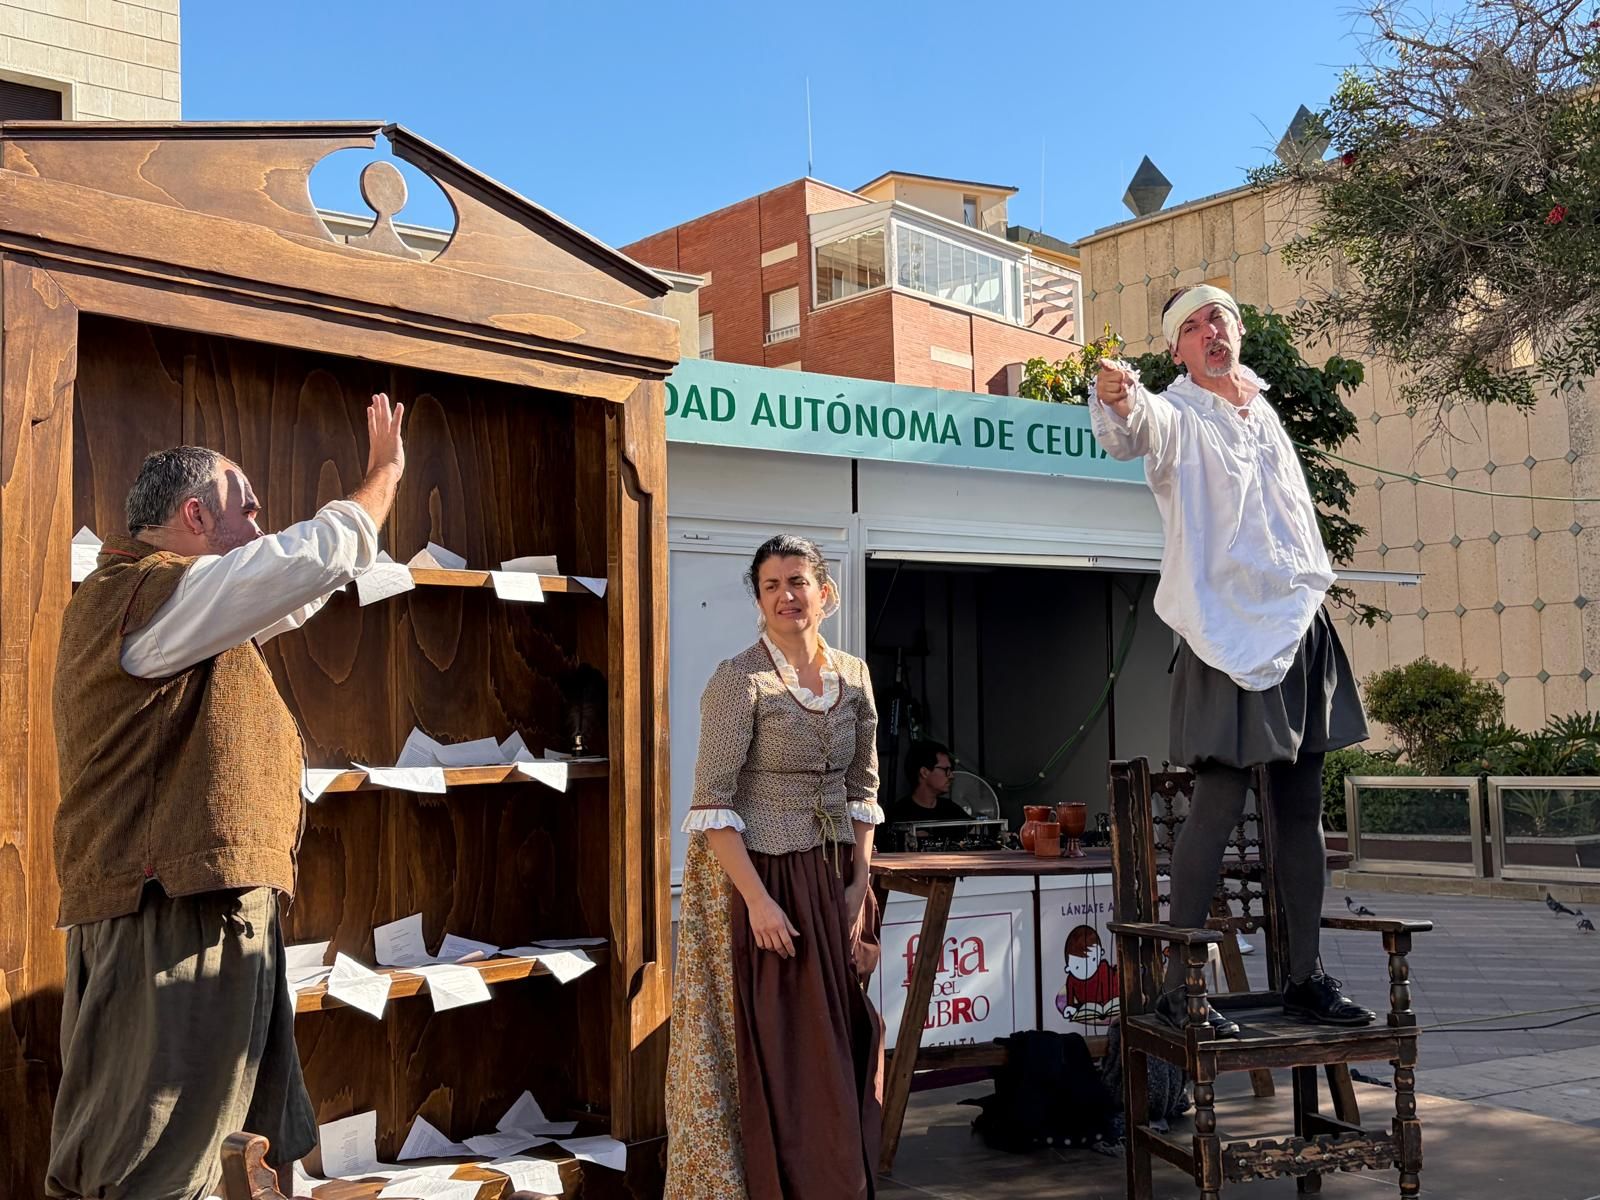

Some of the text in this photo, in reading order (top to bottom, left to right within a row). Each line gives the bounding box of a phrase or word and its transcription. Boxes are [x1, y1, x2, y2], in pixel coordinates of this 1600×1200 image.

[751, 392, 961, 446] AUTÓNOMA
[974, 417, 1014, 451] DE
[1061, 902, 1104, 916] LÁNZATE
[902, 934, 989, 983] fria
